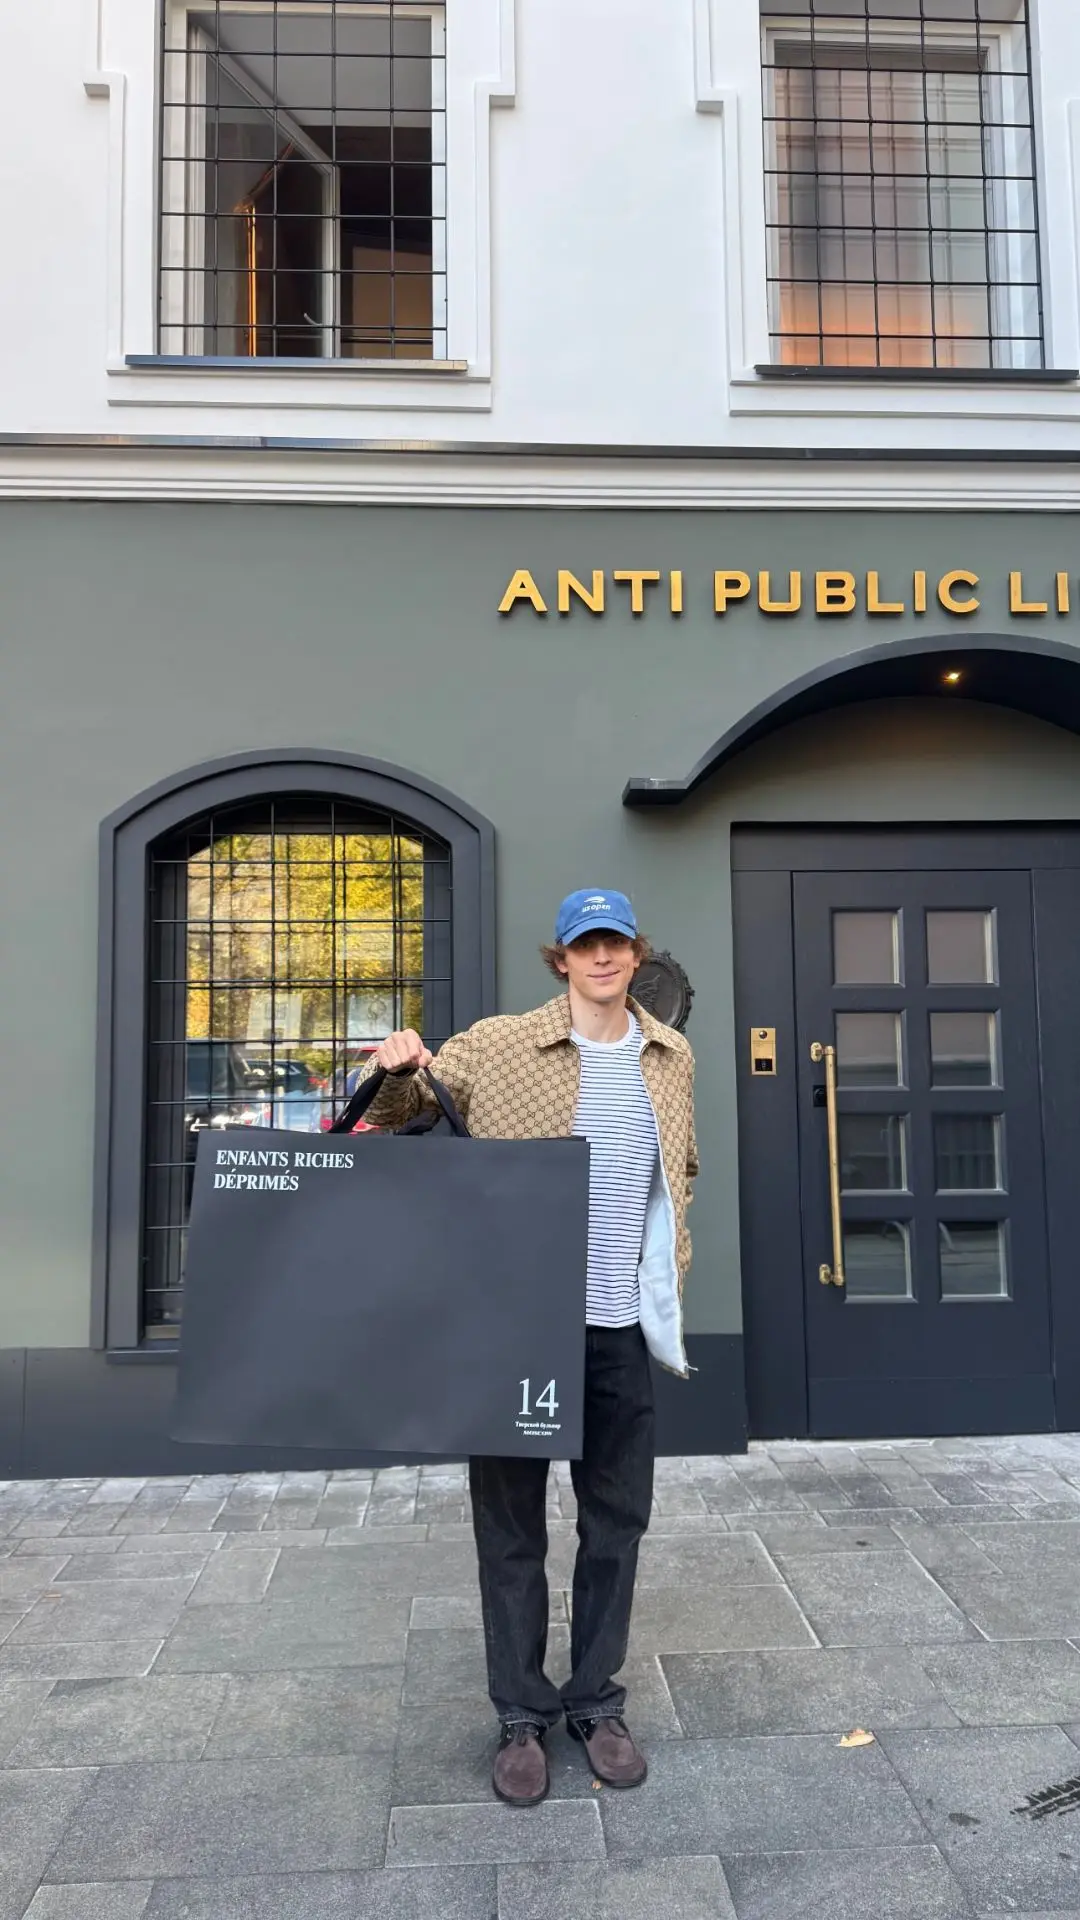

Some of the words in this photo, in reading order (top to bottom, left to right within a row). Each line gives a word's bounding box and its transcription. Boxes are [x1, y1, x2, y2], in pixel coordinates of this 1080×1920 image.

[498, 570, 683, 612] ANTI
[714, 570, 980, 613] PUBLIC
[215, 1149, 289, 1167] ENFANTS
[294, 1152, 354, 1169] RICHES
[213, 1168, 299, 1191] DÉPRIMÉS
[518, 1378, 559, 1417] 14
